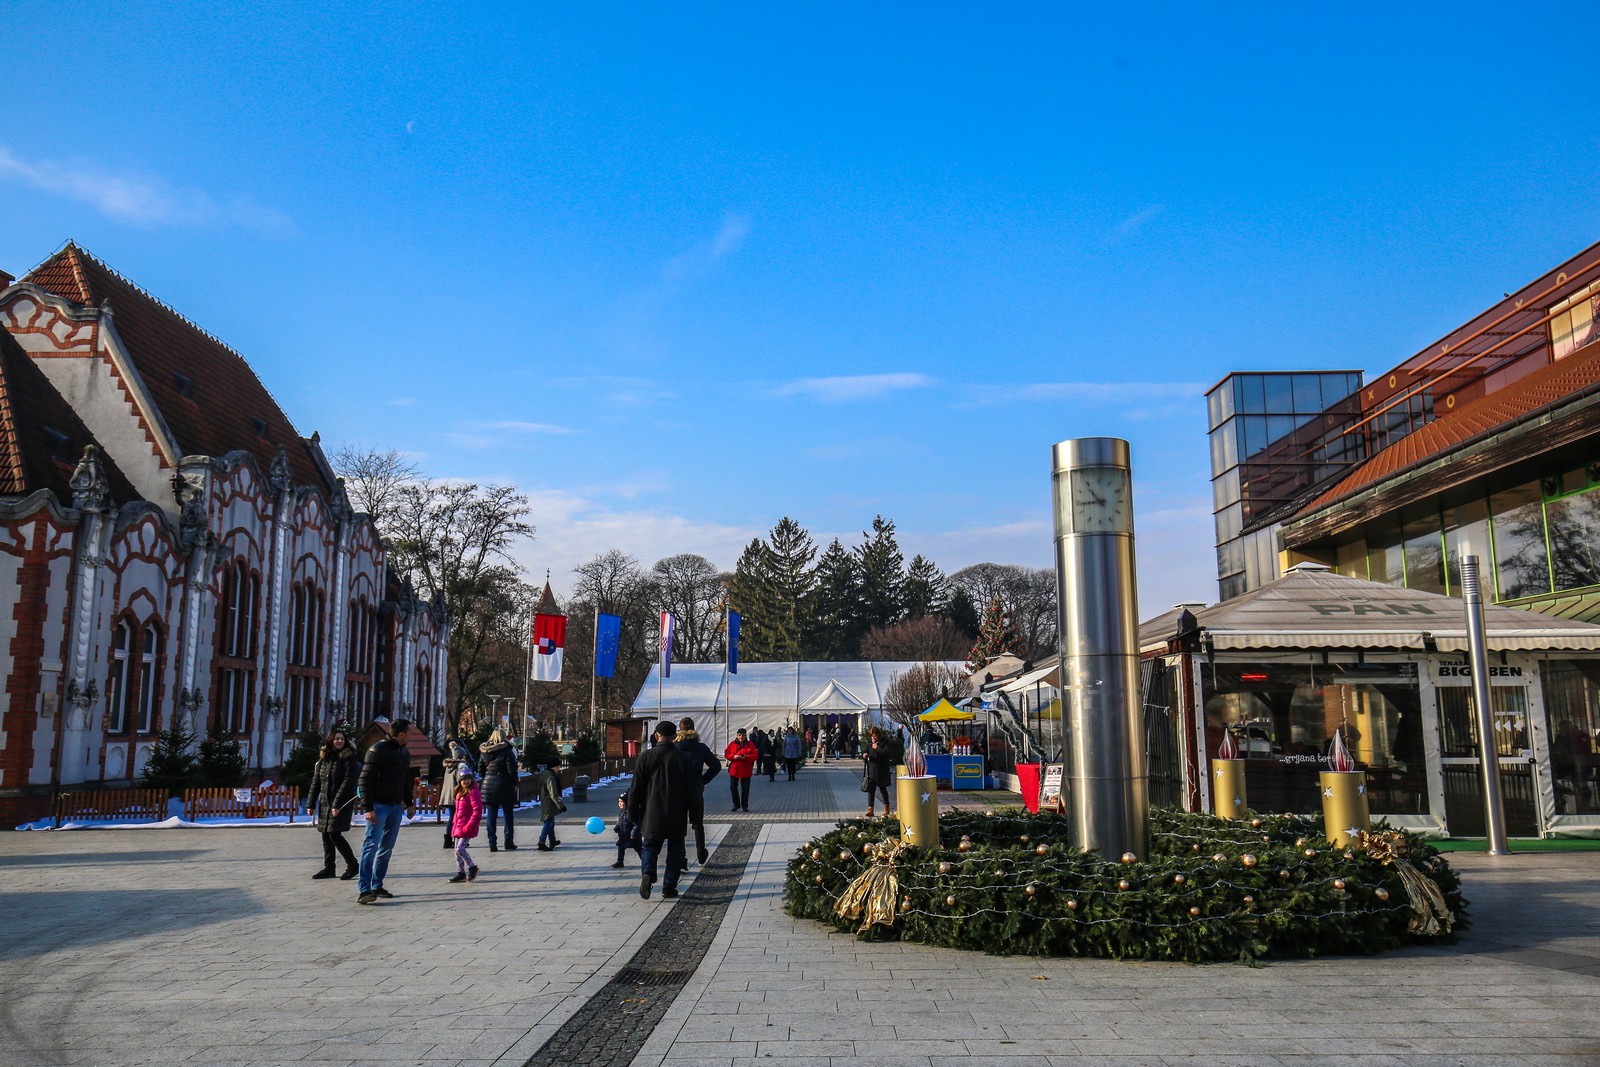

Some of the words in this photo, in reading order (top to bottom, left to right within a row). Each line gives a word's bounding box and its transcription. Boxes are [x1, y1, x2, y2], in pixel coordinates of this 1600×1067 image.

[1309, 604, 1437, 615] PAN
[1439, 667, 1471, 676] BIG
[1490, 667, 1522, 676] BEN
